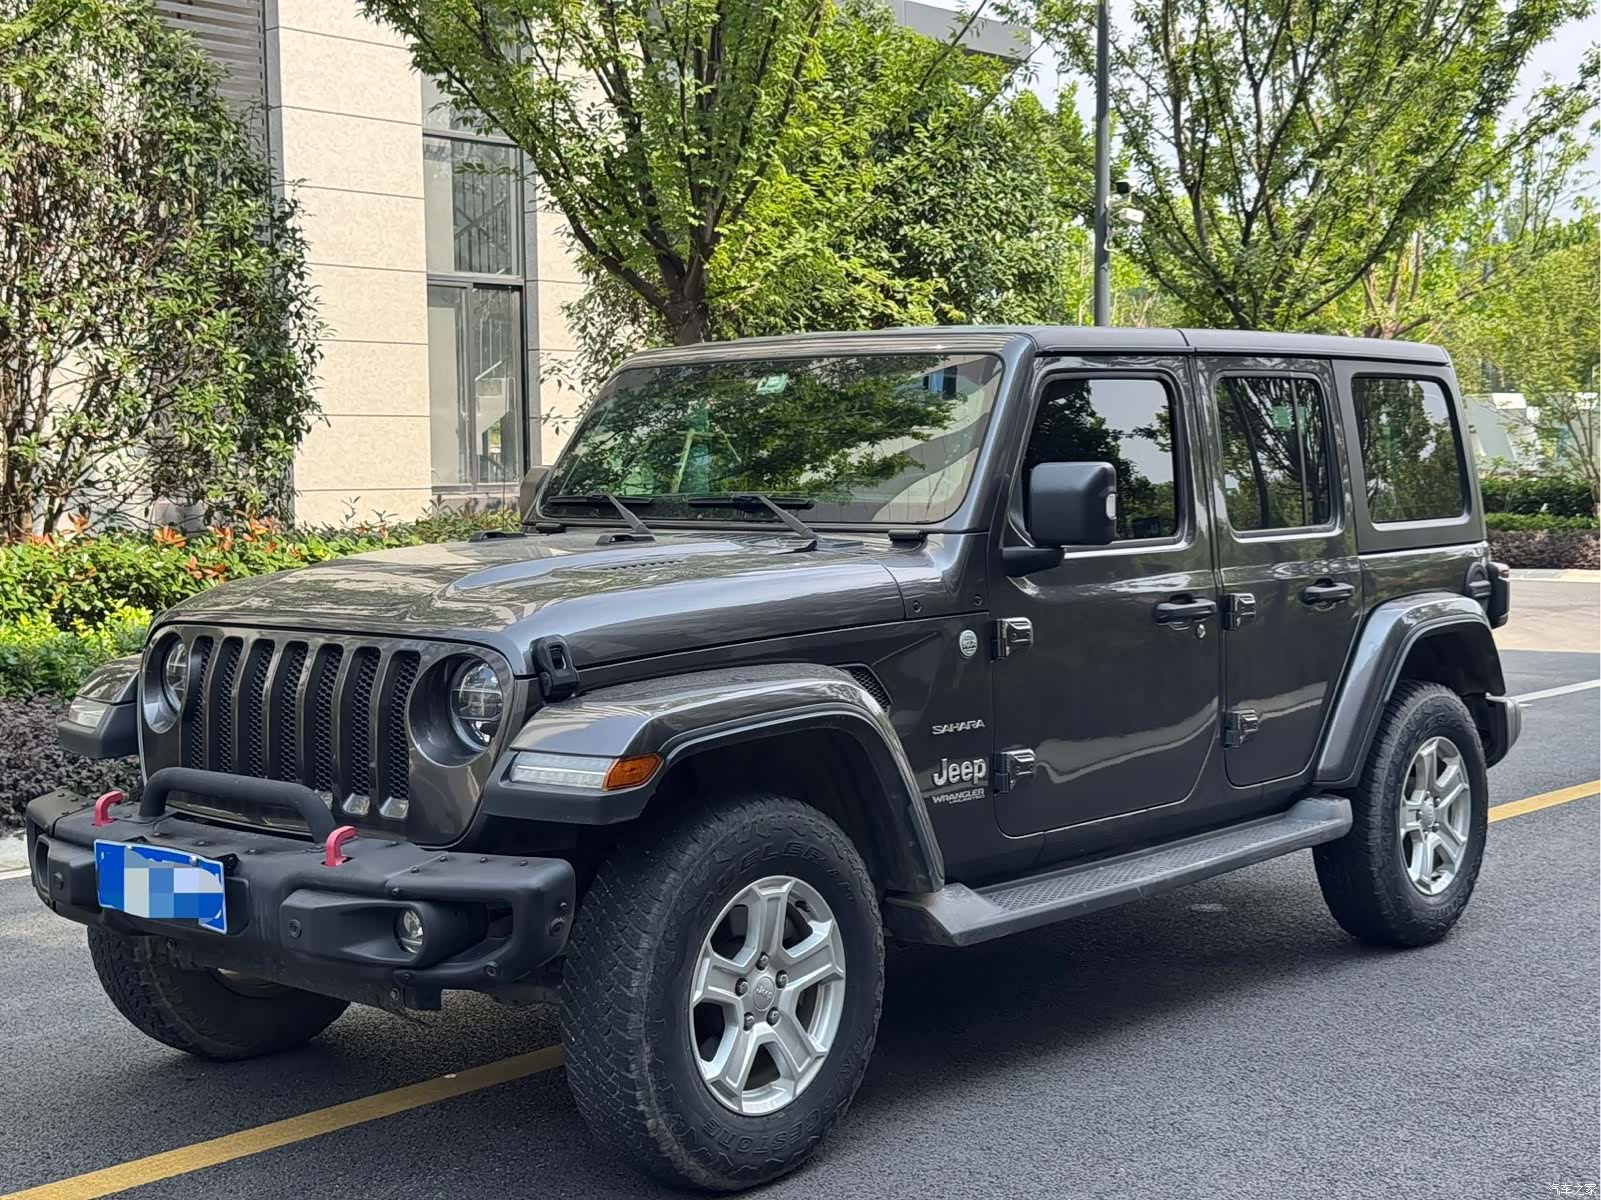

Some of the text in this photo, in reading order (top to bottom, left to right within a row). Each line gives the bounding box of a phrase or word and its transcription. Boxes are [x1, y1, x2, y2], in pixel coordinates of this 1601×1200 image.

[932, 719, 985, 735] SAHARA
[933, 758, 987, 786] Jeep
[932, 788, 984, 803] WRANGLER
